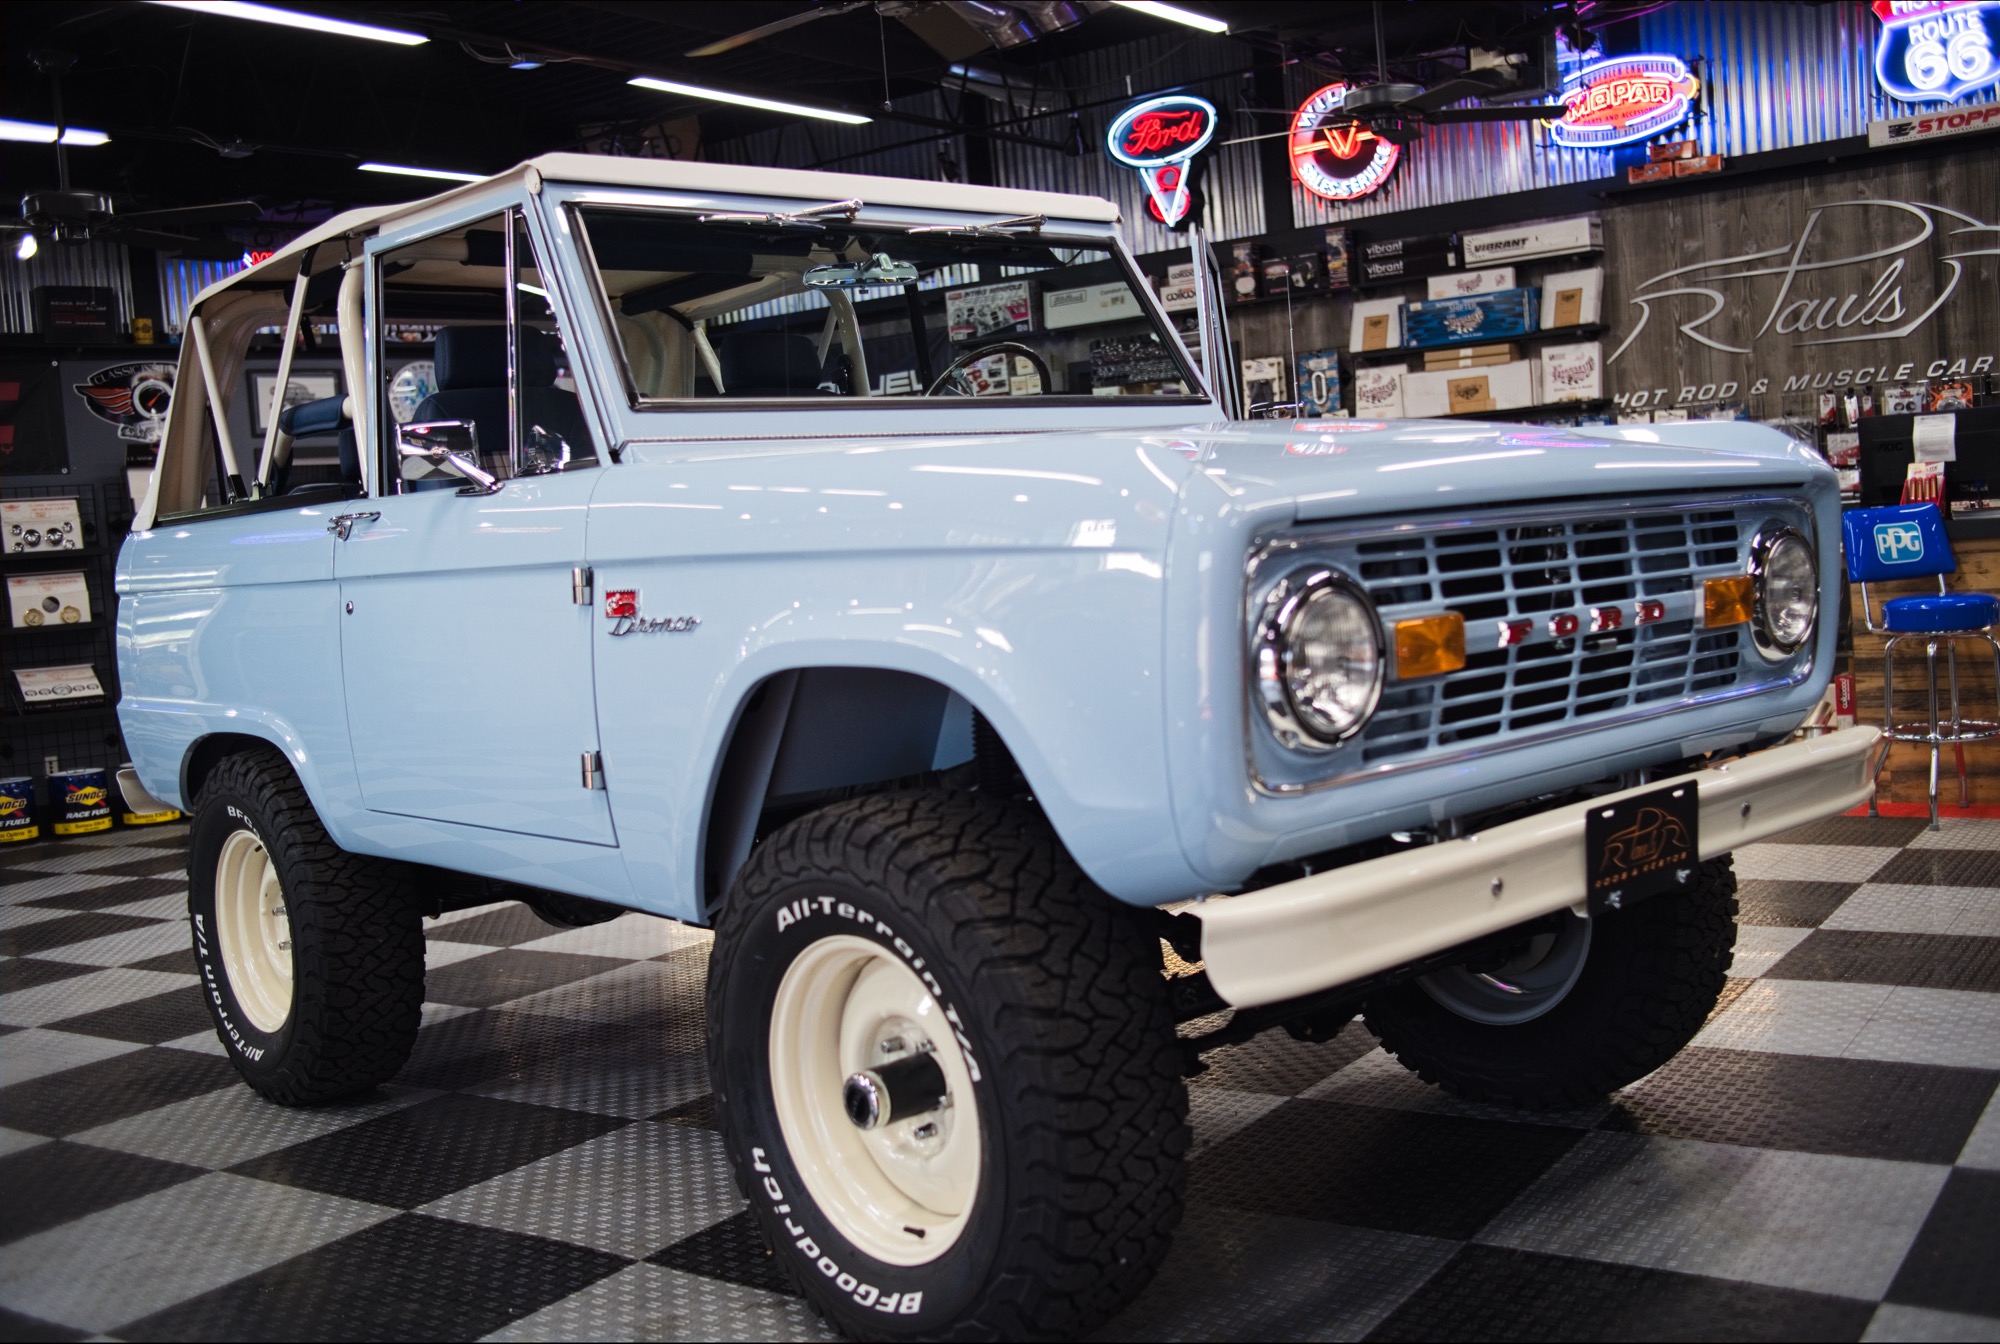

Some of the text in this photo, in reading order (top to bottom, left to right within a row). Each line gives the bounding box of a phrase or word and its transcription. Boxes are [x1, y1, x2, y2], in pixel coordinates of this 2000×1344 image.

[1908, 10, 1983, 45] ROUTE
[1905, 29, 1991, 90] 66
[1566, 79, 1671, 122] MOPAR
[1124, 111, 1205, 155] Ford
[1366, 241, 1402, 254] vibrant
[1475, 238, 1528, 252] VIBRANT
[1367, 261, 1403, 274] vibrant
[94, 364, 140, 386] CLASSIC
[1613, 356, 1994, 409] HOT ROD & MUSCLE CAR
[1877, 527, 1921, 559] PPG
[1497, 598, 1665, 648] FORD
[68, 789, 107, 802] SUNOCO
[5, 817, 31, 827] FUELS
[66, 806, 111, 820] RACE FUELS
[776, 896, 982, 1082] All-Terrain T/A
[752, 1147, 924, 1315] BFGoodrich
